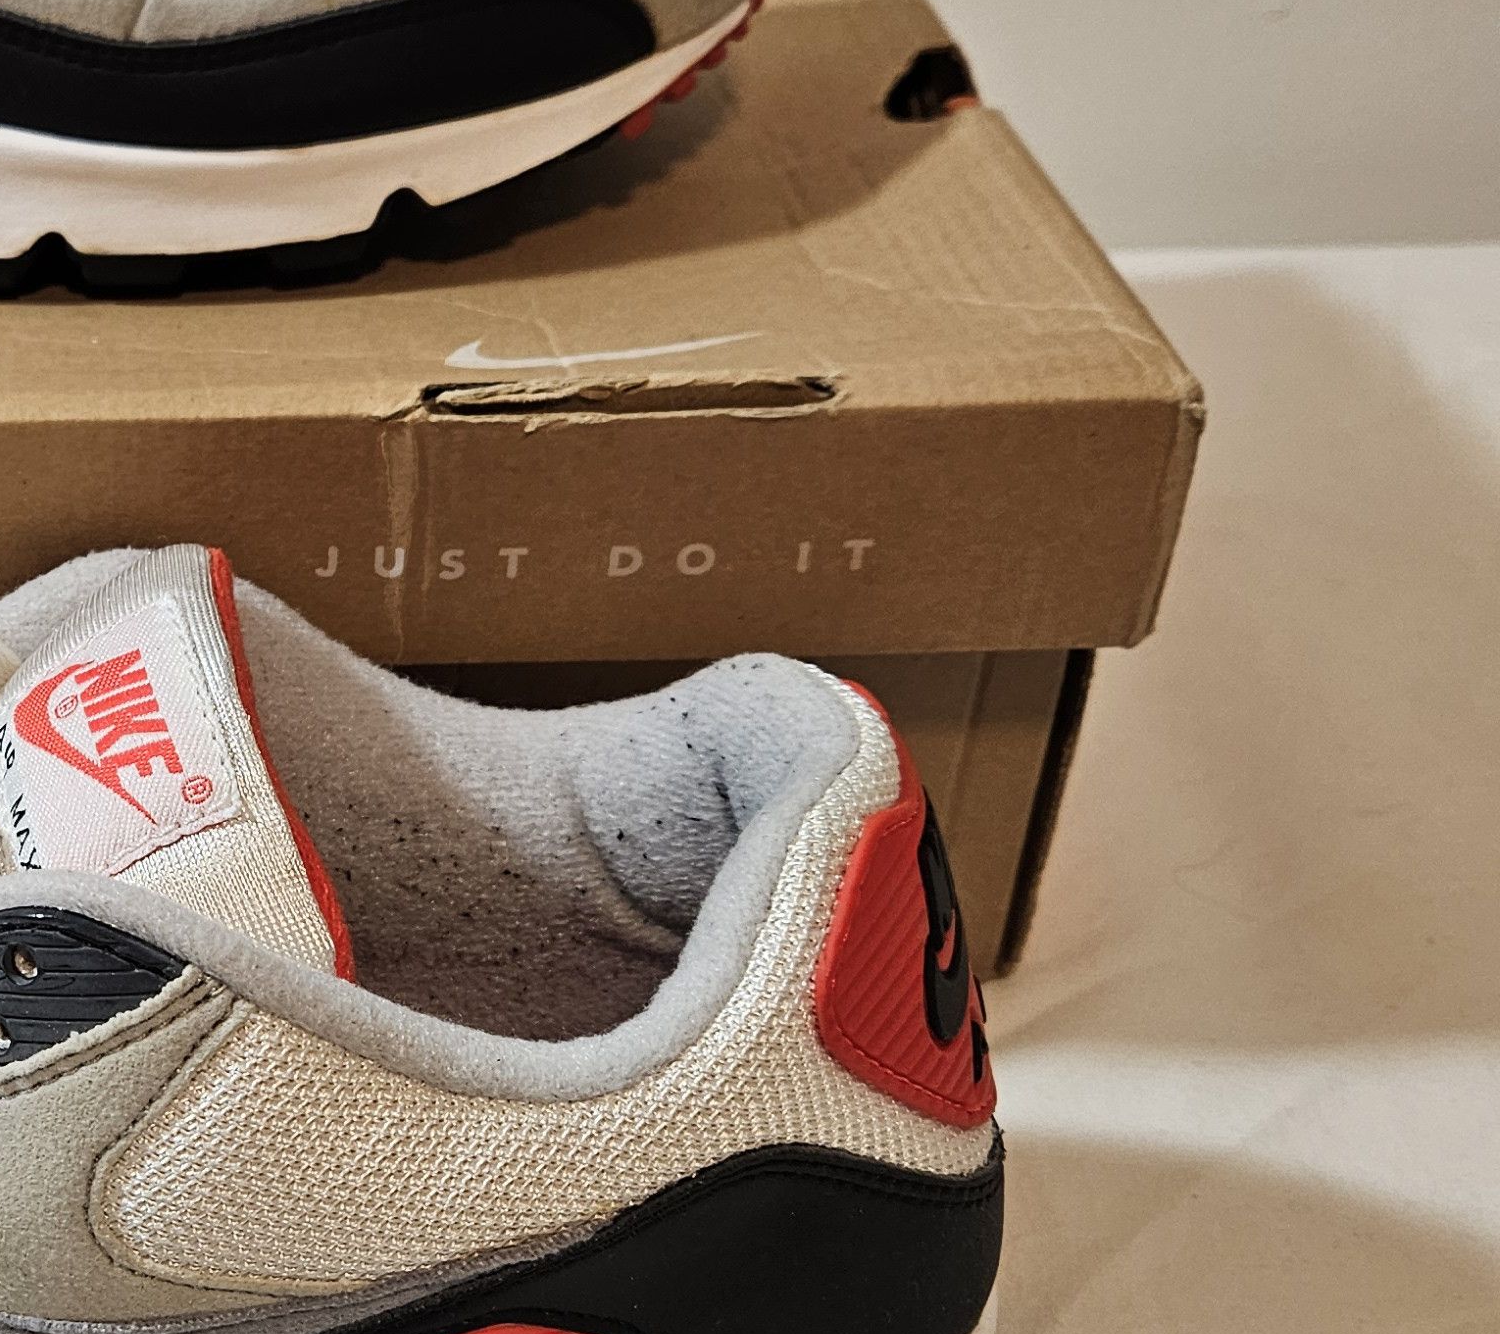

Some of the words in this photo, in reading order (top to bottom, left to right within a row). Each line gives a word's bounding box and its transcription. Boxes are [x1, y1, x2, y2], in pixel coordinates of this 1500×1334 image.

[314, 544, 529, 581] JUST
[606, 543, 717, 579] DO
[797, 538, 876, 573] IT
[73, 648, 184, 778] NIKE
[10, 793, 42, 871] MAX
